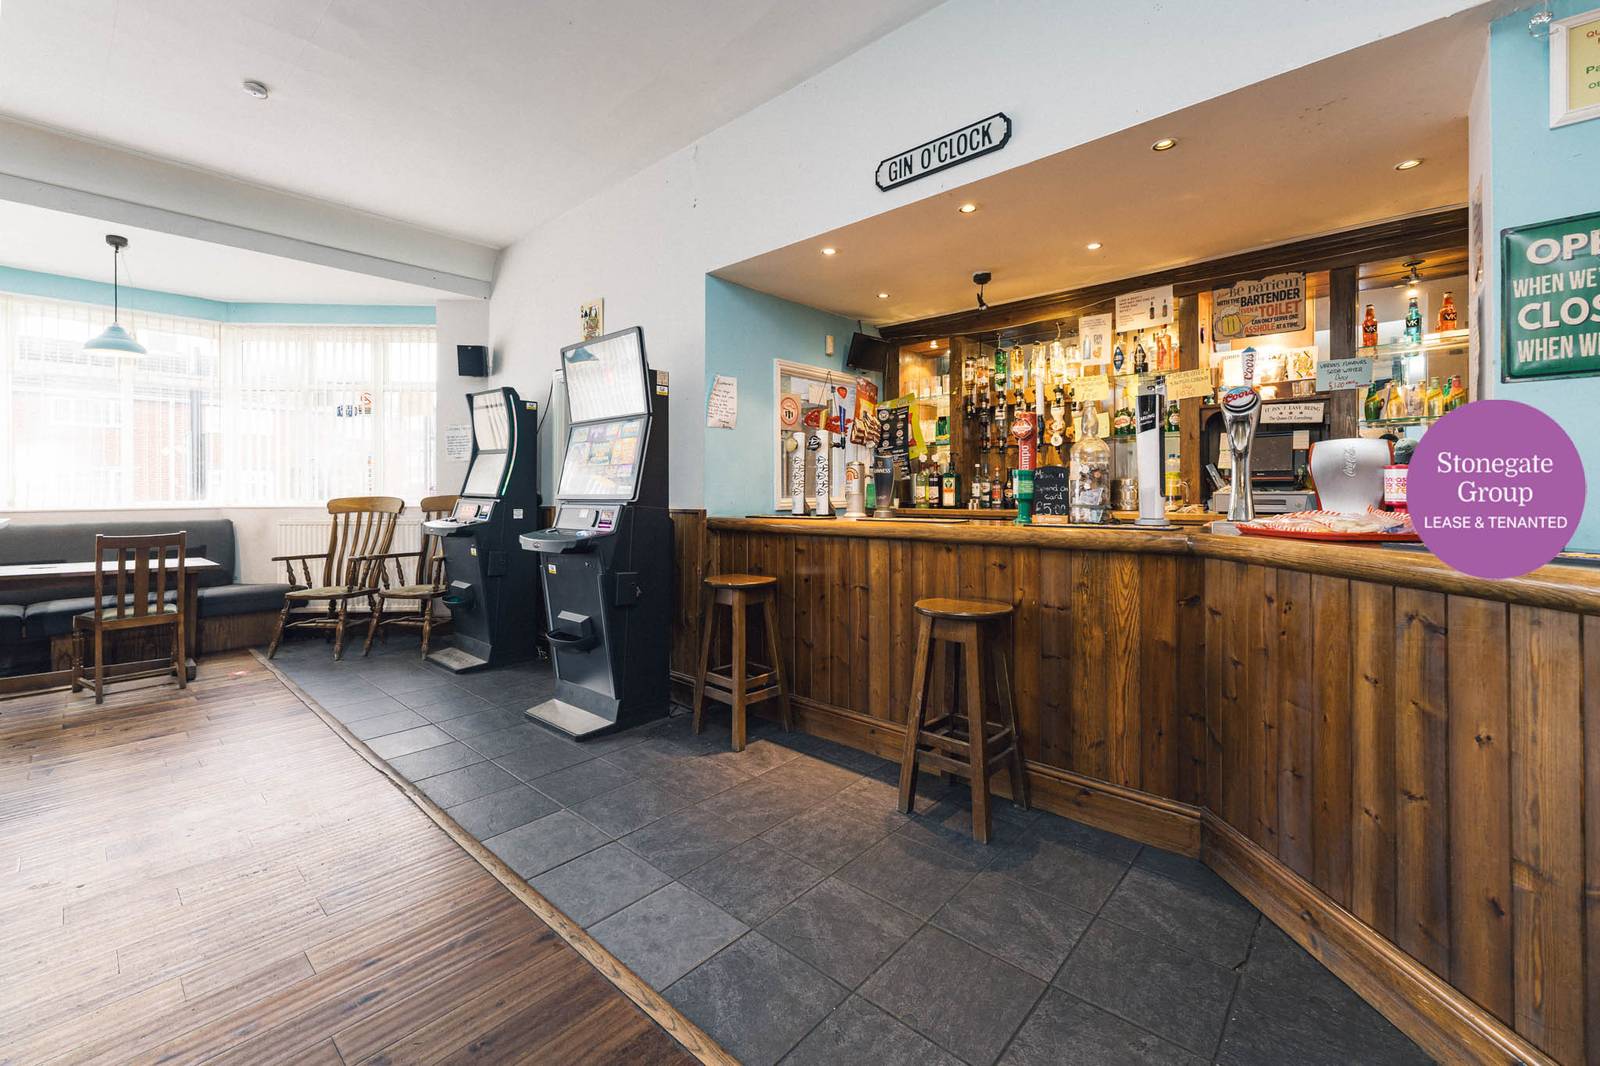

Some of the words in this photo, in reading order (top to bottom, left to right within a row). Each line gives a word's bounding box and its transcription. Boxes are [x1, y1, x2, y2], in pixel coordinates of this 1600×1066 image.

[888, 155, 913, 182] GIN
[921, 122, 993, 169] O'CLOCK
[1513, 272, 1565, 298] WHEN
[1240, 287, 1300, 307] BARTENDER
[1244, 325, 1276, 335] ASSHOLE
[1251, 318, 1261, 326] CAN
[1261, 317, 1273, 325] ONLY
[1273, 315, 1288, 323] SERVE
[1406, 319, 1418, 327] VK
[1517, 334, 1573, 363] WHEN
[1578, 332, 1600, 358] W
[1243, 353, 1255, 381] Coors
[1223, 388, 1254, 404] Coors
